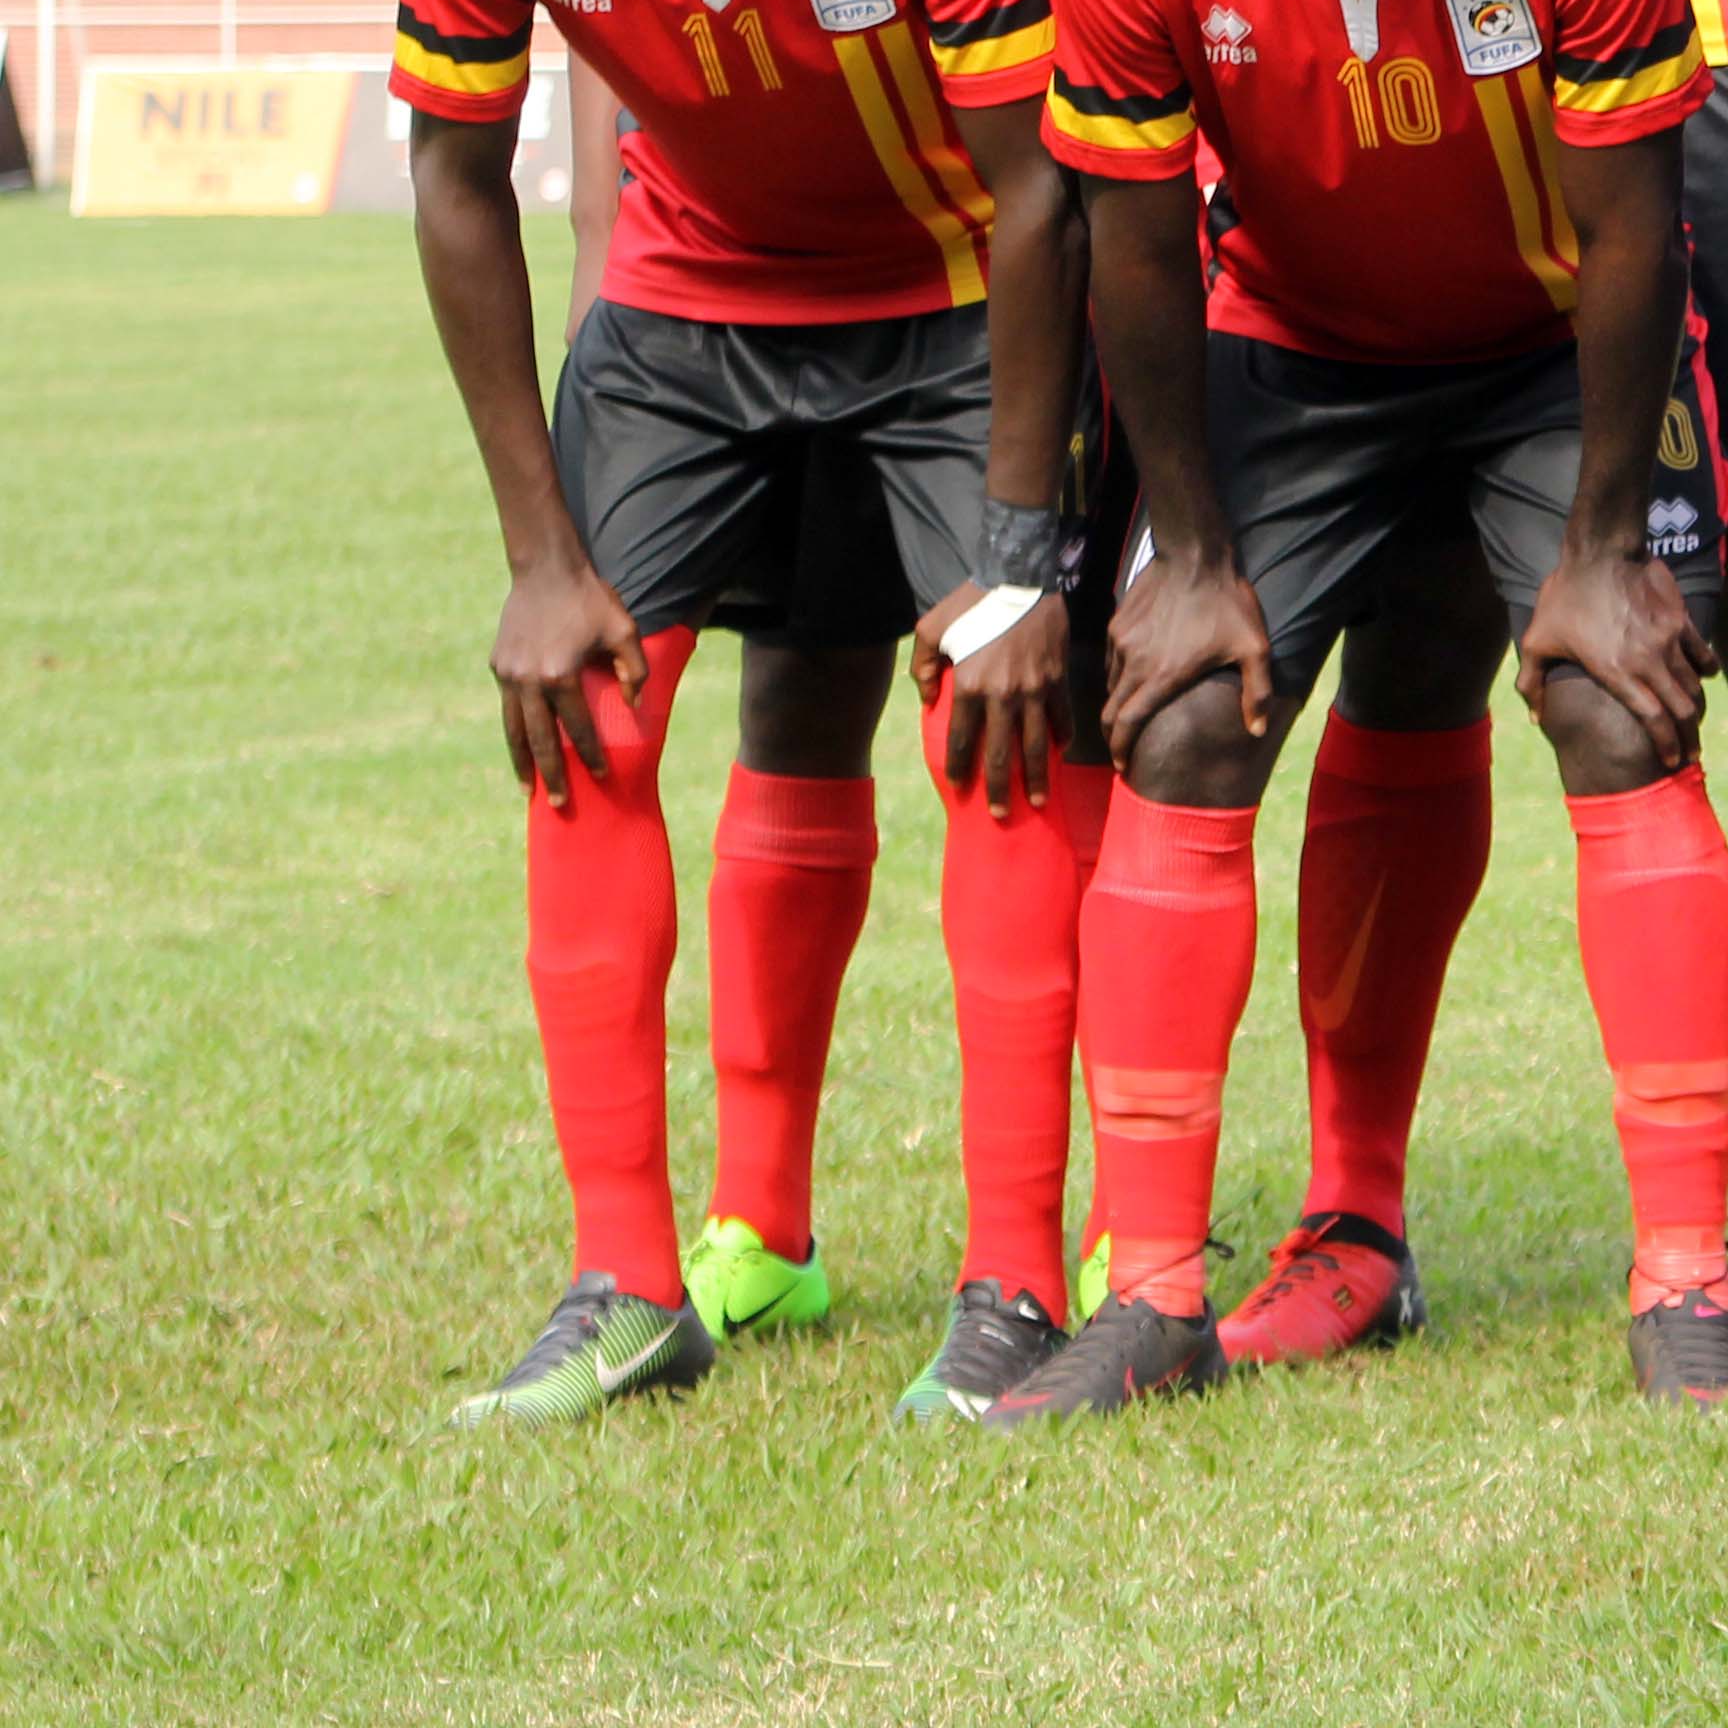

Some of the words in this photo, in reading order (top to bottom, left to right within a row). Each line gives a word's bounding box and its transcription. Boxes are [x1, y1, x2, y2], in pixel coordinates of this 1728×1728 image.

[834, 4, 877, 21] FUFA
[681, 7, 783, 98] 11
[1479, 42, 1524, 64] FUFA
[142, 90, 290, 138] NILE
[1337, 56, 1442, 150] 10
